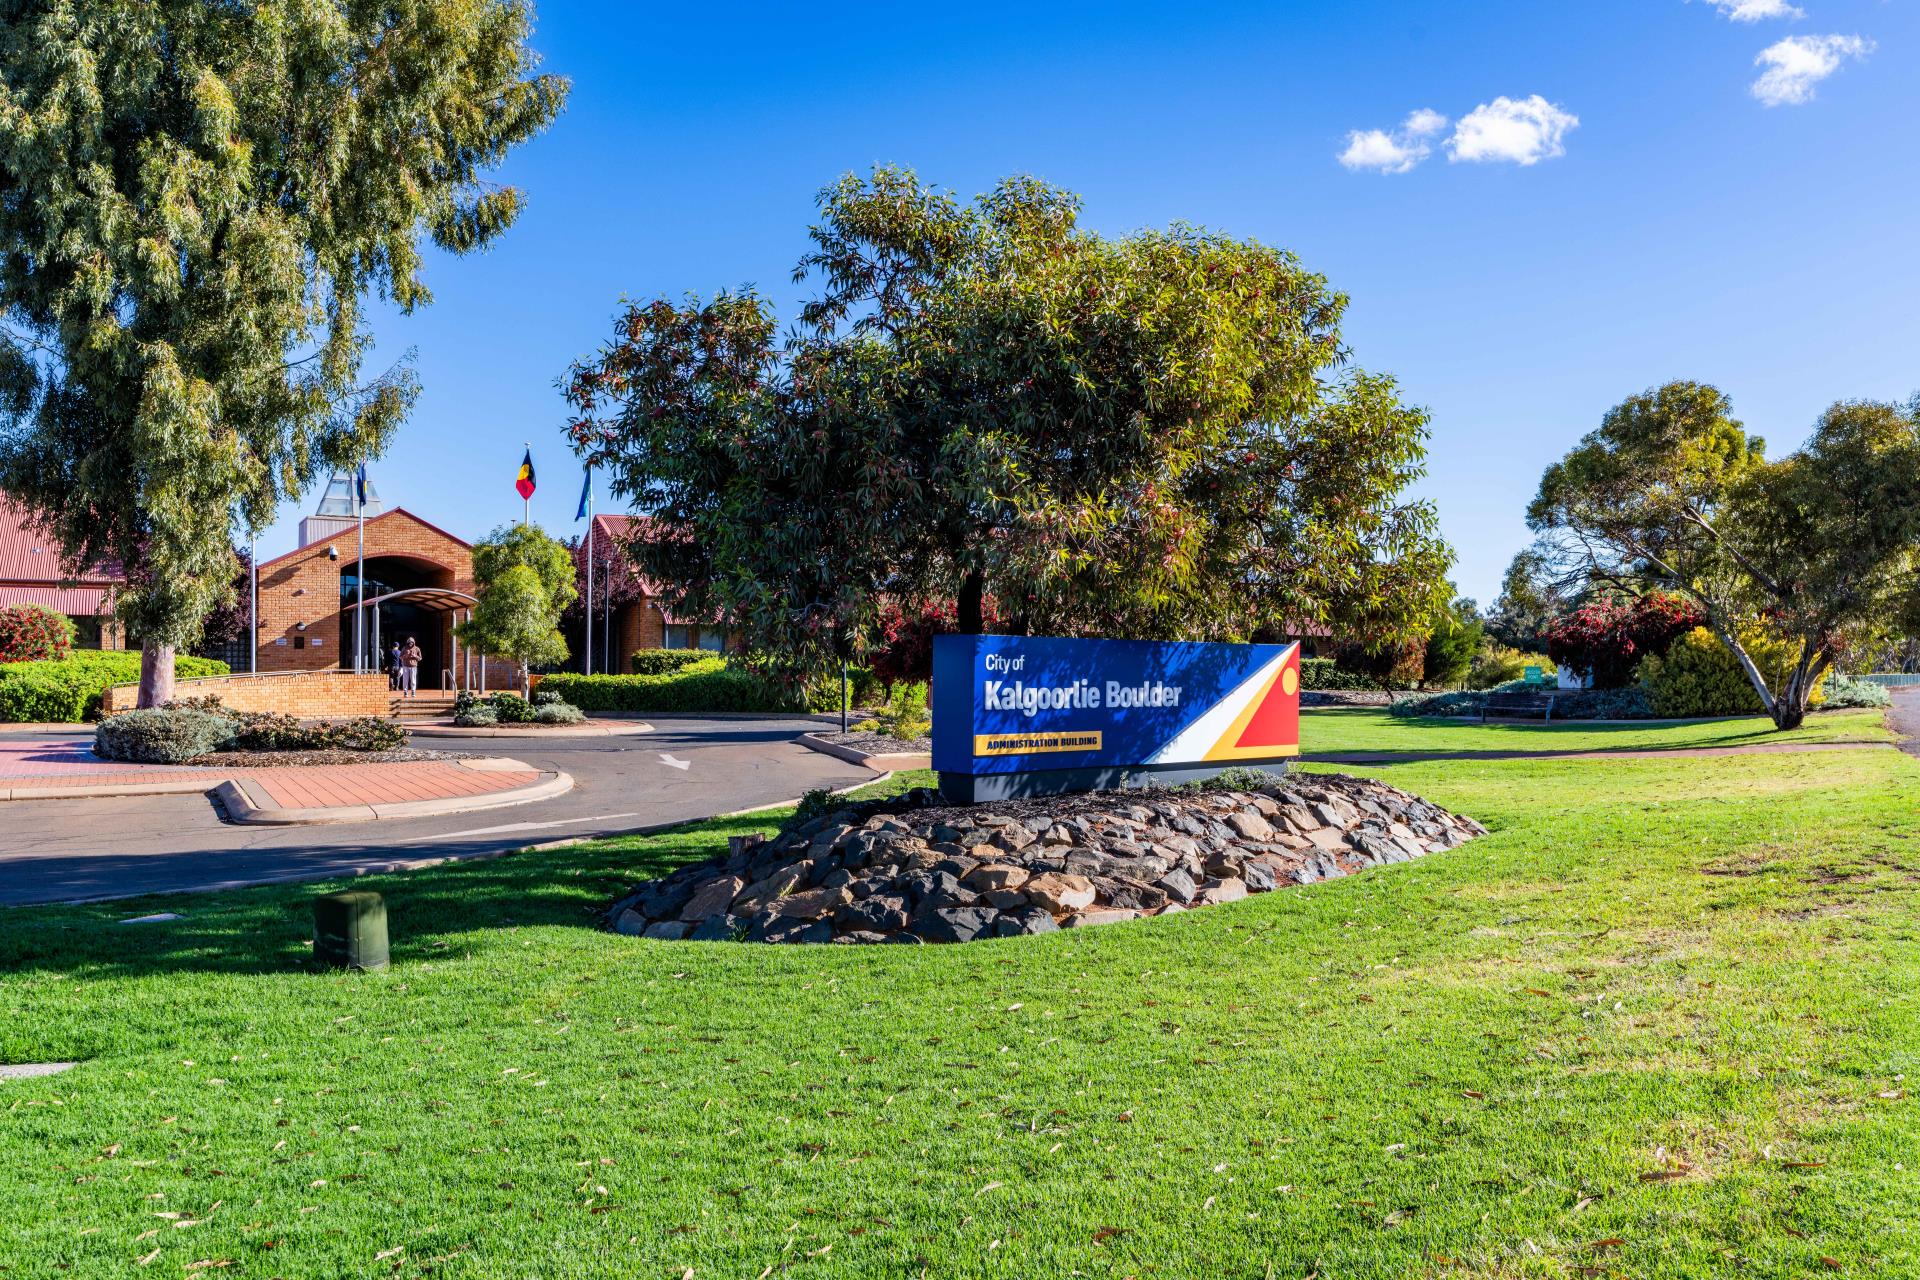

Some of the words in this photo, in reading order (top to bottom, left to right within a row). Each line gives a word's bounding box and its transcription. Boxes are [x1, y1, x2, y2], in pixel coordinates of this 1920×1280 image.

[985, 654, 1010, 674] City
[1012, 655, 1025, 671] of
[985, 678, 1100, 717] Kalgoorlie
[1105, 680, 1182, 708] Boulder
[987, 738, 1058, 750] ADMINISTRATION
[1060, 737, 1097, 746] BUILDING
